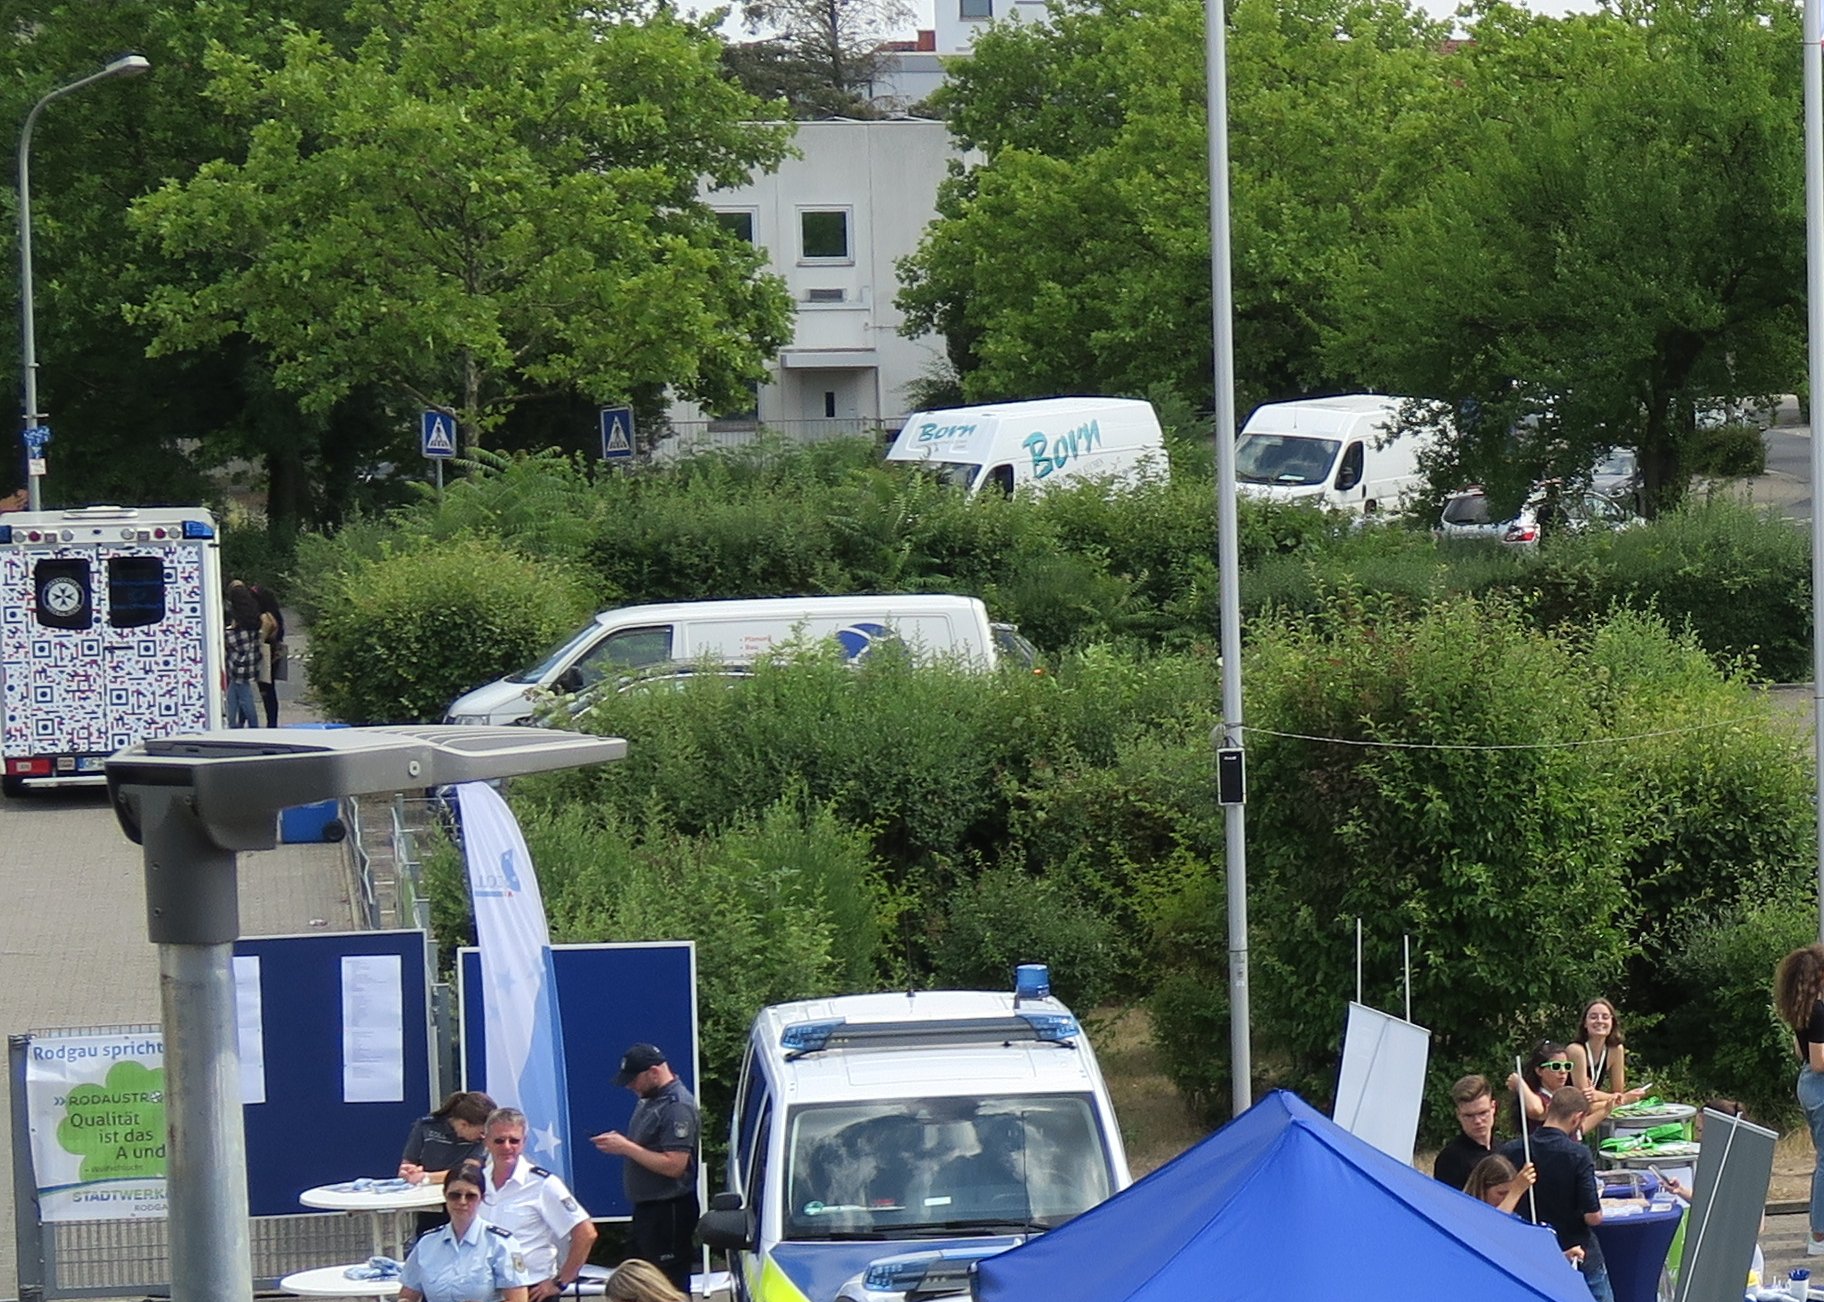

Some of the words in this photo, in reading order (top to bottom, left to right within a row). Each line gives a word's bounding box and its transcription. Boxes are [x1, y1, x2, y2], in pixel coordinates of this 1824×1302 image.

[918, 423, 978, 442] Born
[1022, 419, 1101, 479] Born
[33, 1046, 98, 1062] Rodgau
[103, 1041, 164, 1060] spricht
[70, 1111, 140, 1129] Qualität
[99, 1132, 119, 1144] ist
[123, 1129, 154, 1143] das
[116, 1148, 128, 1160] A
[133, 1143, 166, 1159] und
[72, 1188, 167, 1203] STADTWERK
[134, 1203, 168, 1212] RODGA
